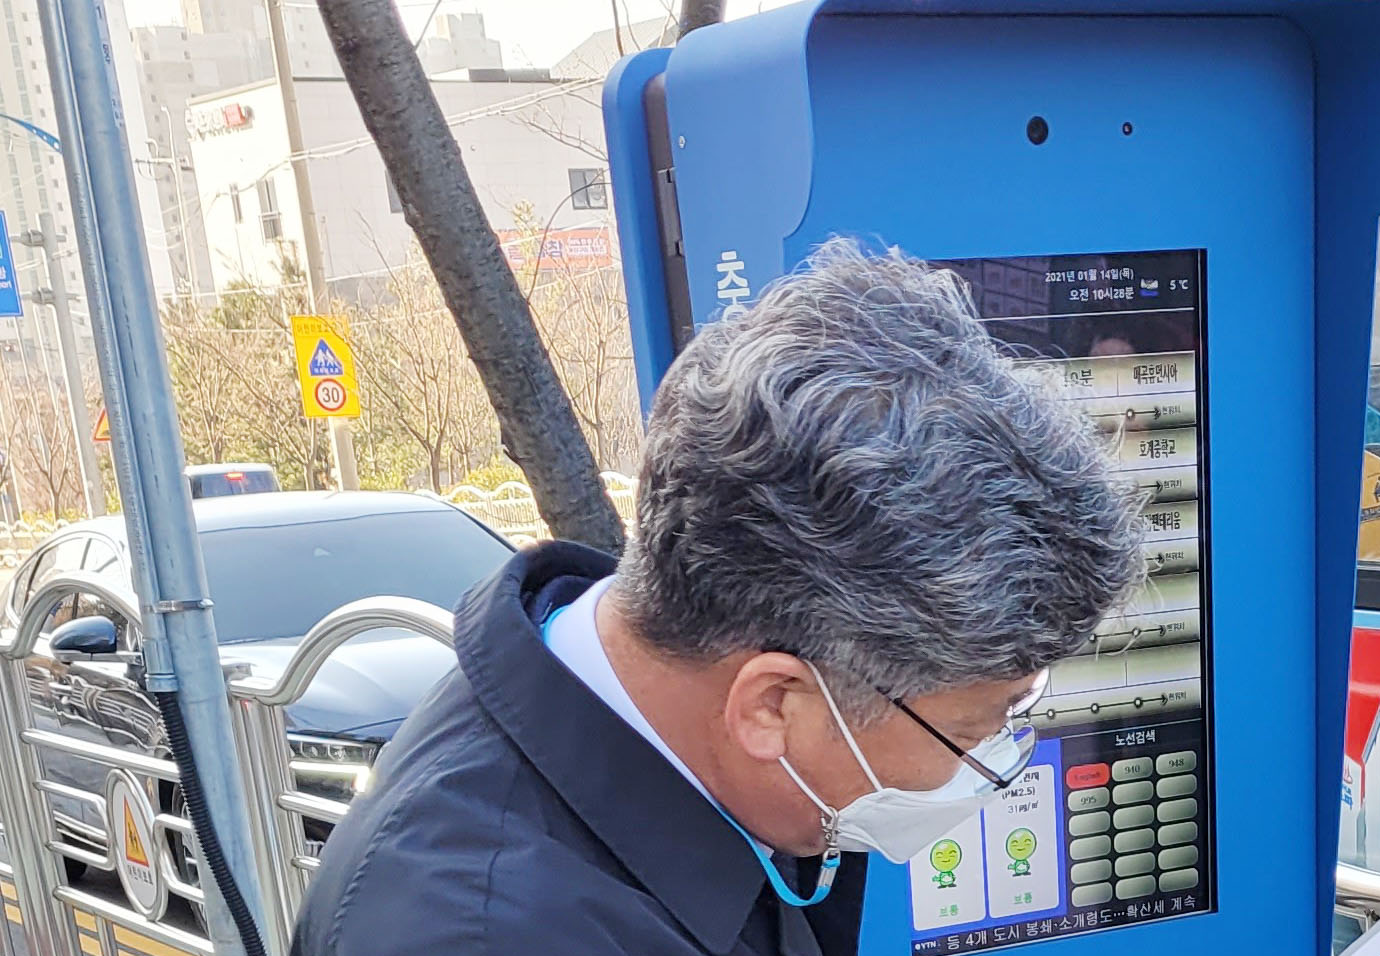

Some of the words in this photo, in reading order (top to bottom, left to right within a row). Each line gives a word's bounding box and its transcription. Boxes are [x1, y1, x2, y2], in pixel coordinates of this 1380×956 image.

[1045, 271, 1075, 282] 2021년
[1069, 288, 1089, 301] 오전
[322, 386, 339, 403] 30
[1115, 729, 1156, 747] 노선검색
[1168, 758, 1185, 769] 948
[947, 935, 961, 951] 등
[965, 930, 987, 947] 4개
[993, 924, 1020, 942] 도시
[1171, 894, 1196, 912] 계속
